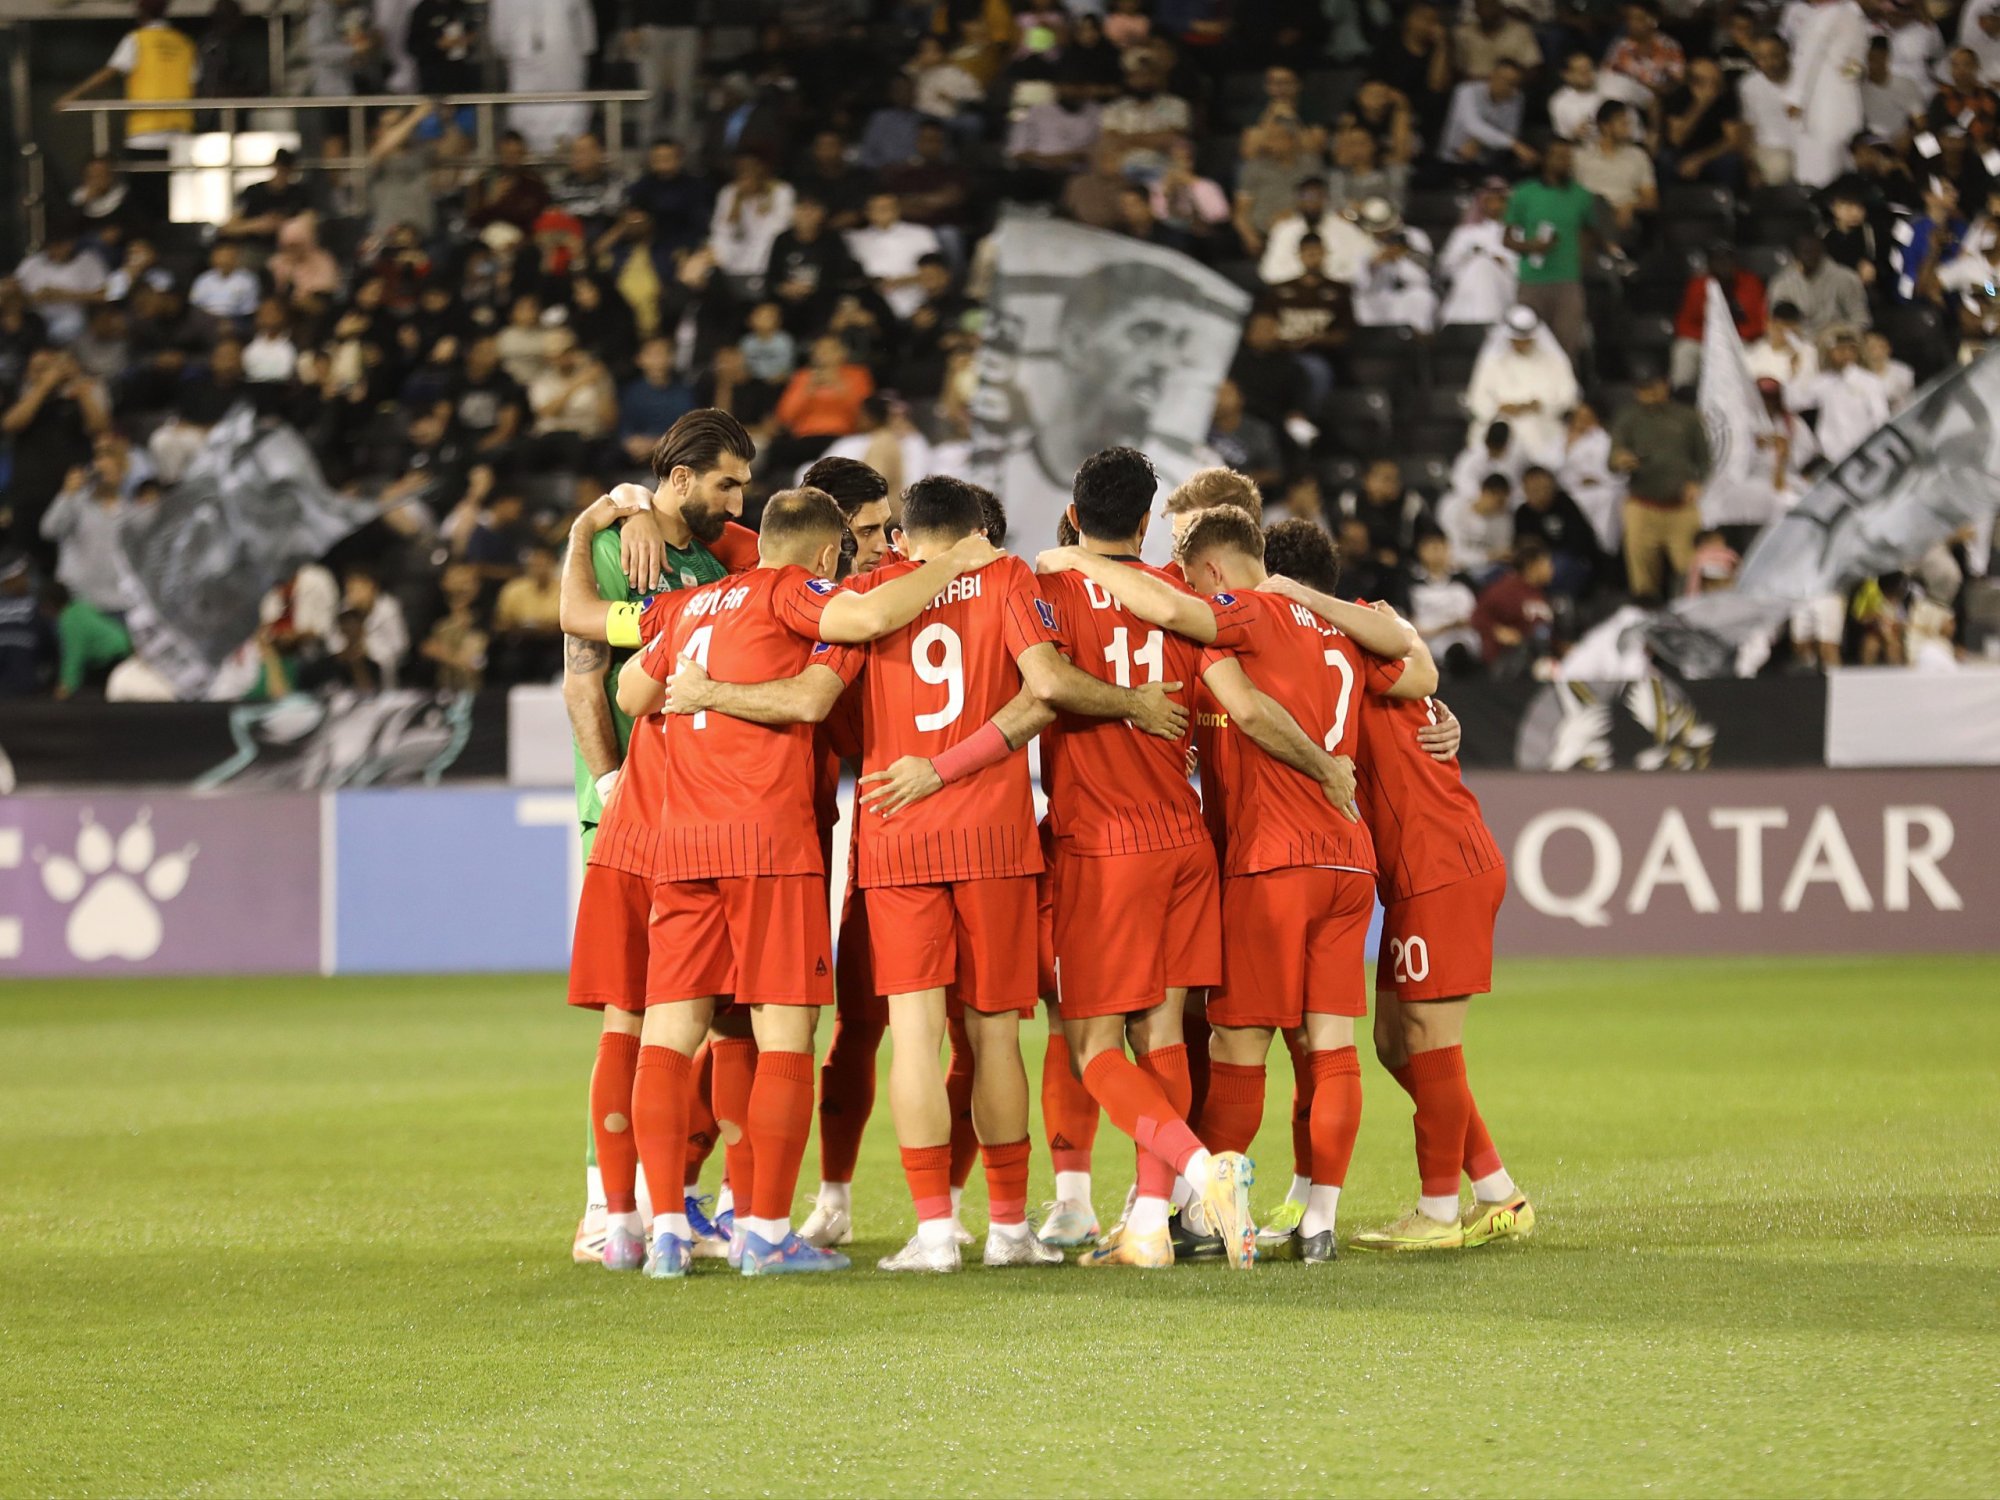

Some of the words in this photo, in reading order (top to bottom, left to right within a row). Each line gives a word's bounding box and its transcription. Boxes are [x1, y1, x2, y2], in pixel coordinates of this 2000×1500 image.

[925, 573, 981, 610] RABI
[911, 622, 965, 732] 9
[1104, 627, 1164, 692] 11
[1512, 805, 1964, 928] QATAR
[1390, 935, 1429, 983] 20
